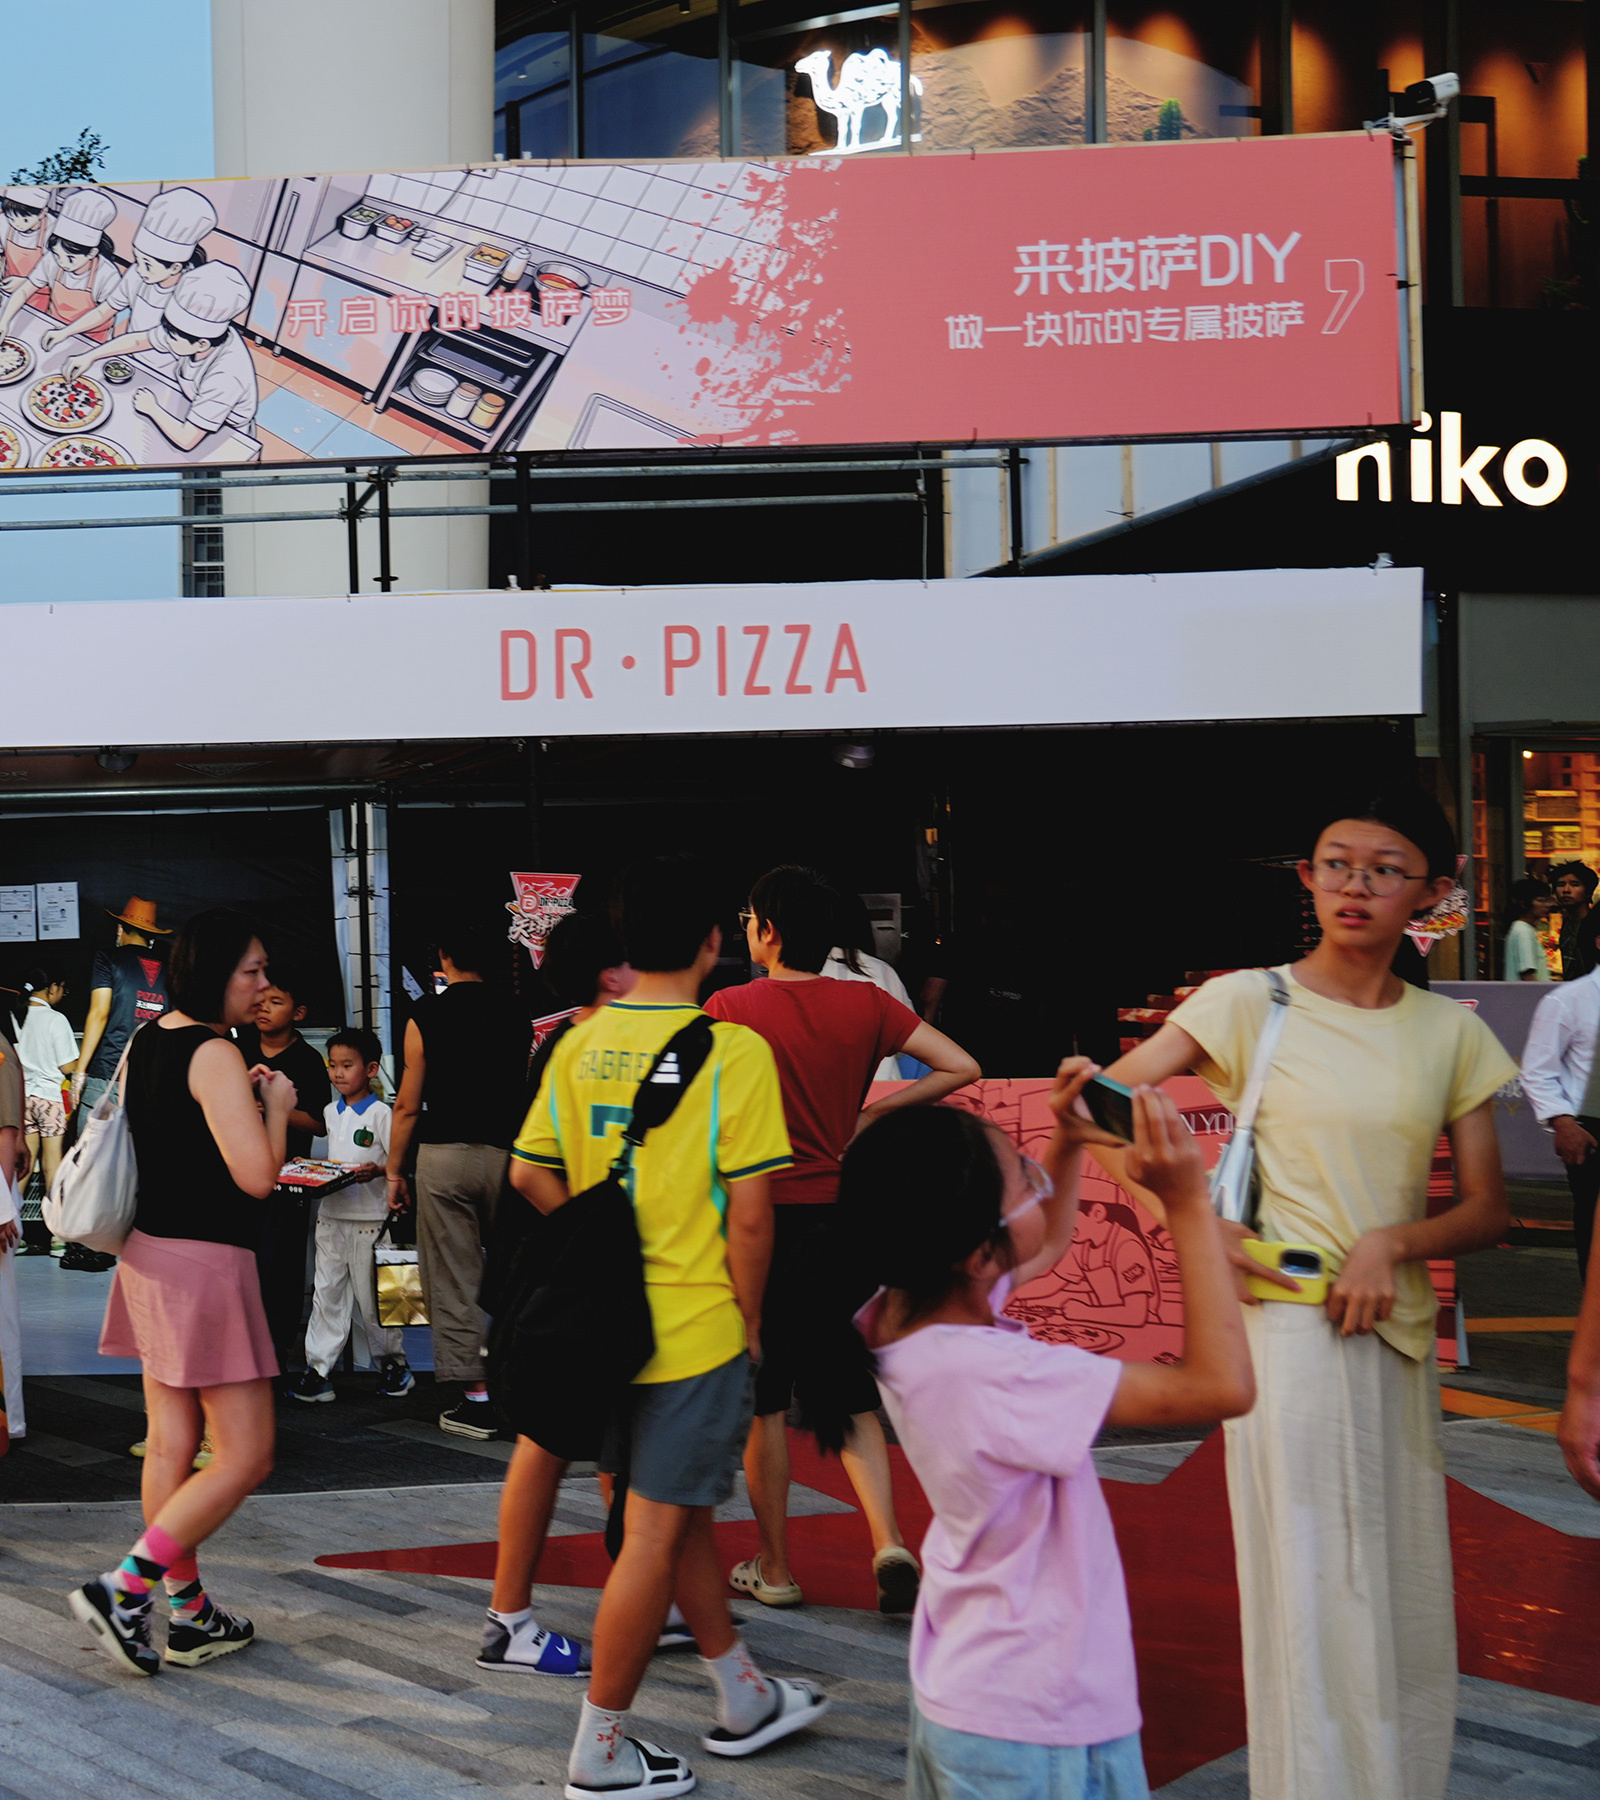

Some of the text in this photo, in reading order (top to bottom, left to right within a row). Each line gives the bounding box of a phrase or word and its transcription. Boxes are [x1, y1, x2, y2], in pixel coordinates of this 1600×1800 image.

[1013, 231, 1302, 297] 来披萨DIY
[287, 288, 633, 337] 开启你的披萨梦
[944, 300, 1306, 350] 做一块你的专属披萨
[1336, 411, 1568, 507] niko
[136, 990, 165, 1004] PIZZA
